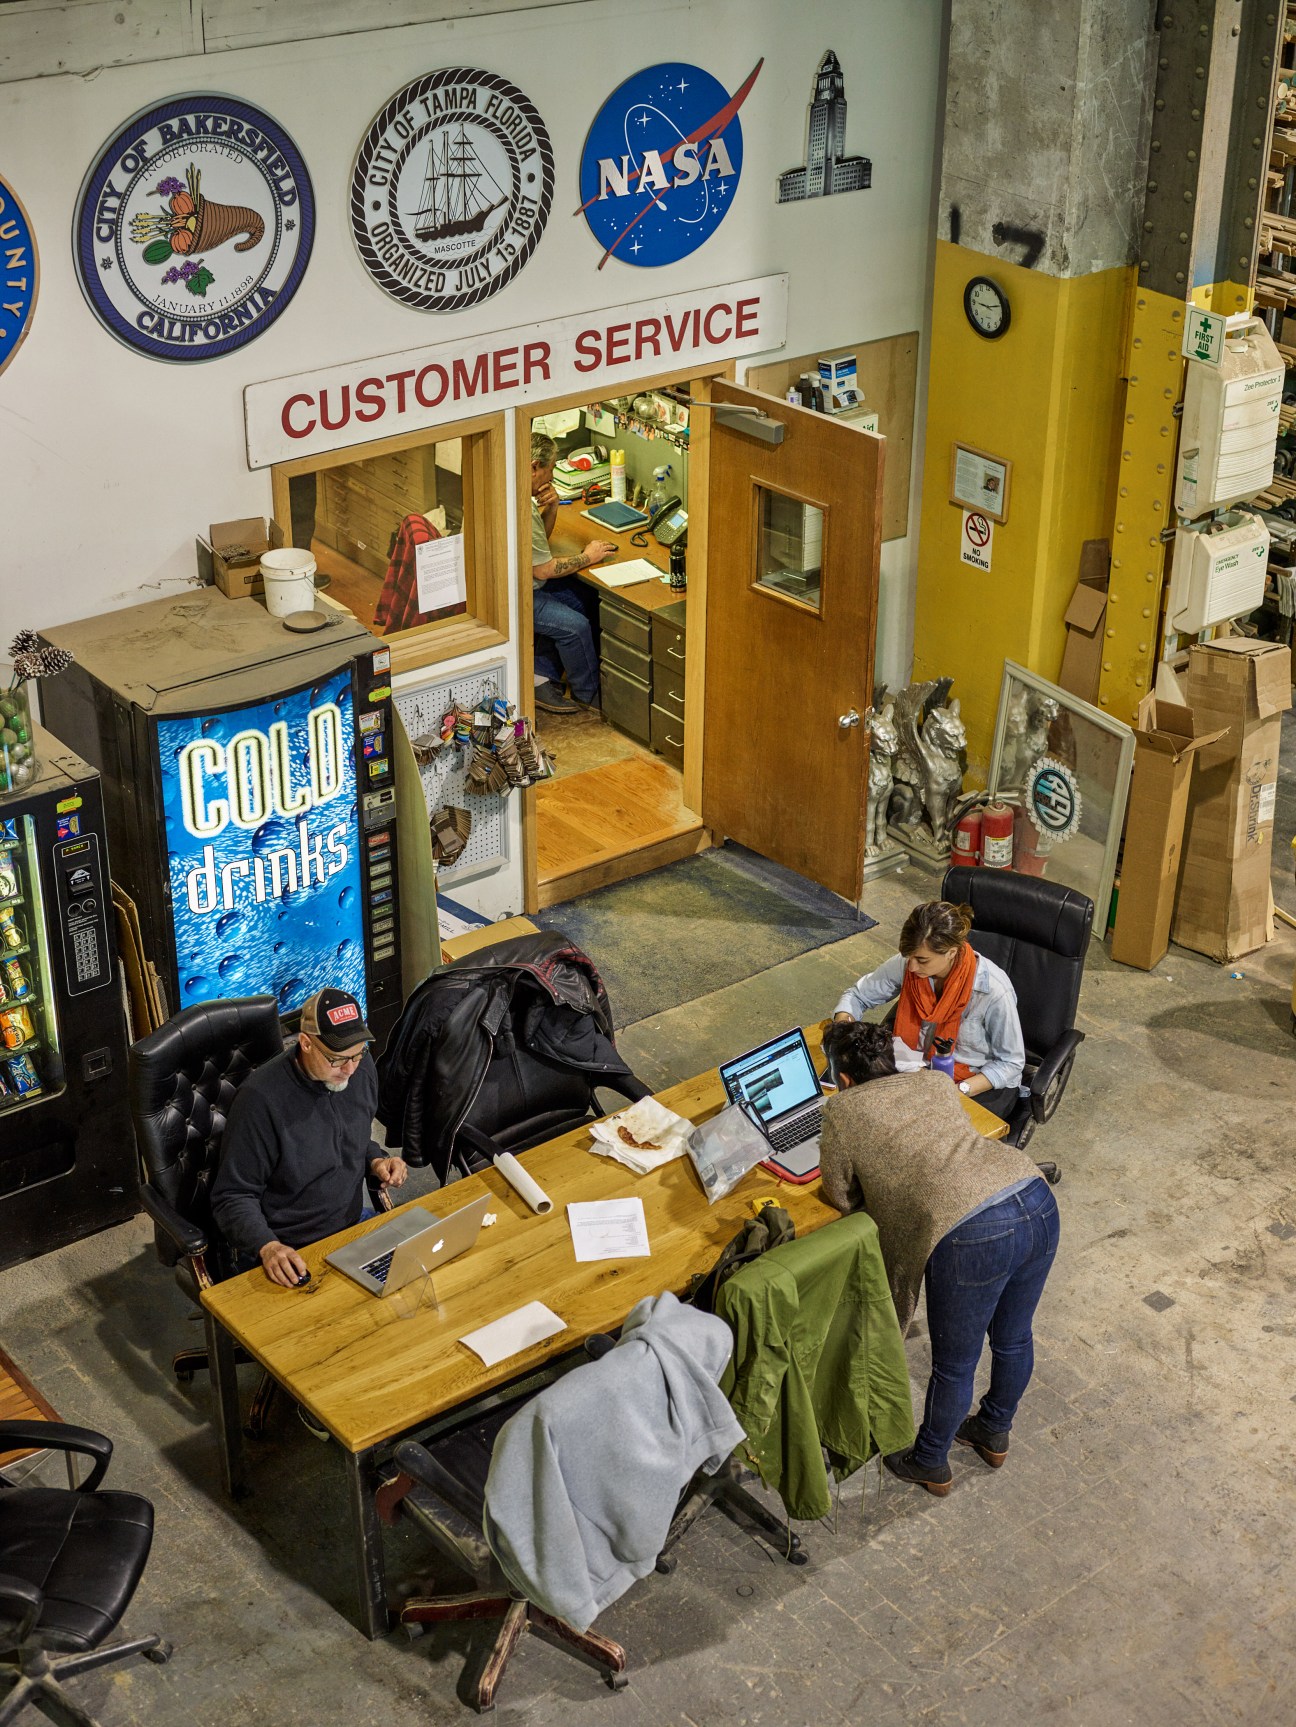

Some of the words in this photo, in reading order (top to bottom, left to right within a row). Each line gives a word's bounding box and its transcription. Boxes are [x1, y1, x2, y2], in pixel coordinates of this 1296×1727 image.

[368, 138, 399, 187] CITY
[393, 109, 415, 140] OF
[419, 86, 478, 118] TAMPA
[484, 93, 537, 164] FLORIDA
[140, 143, 245, 183] INCORPORATED
[597, 137, 736, 201] NASA
[96, 179, 124, 243] CITY
[120, 138, 150, 175] OF
[156, 114, 298, 207] BAKERSFIELD
[370, 221, 446, 293] ORGANIZED
[455, 258, 493, 292] JULY
[495, 238, 517, 264] 15
[511, 194, 538, 239] 1887
[434, 239, 477, 255] MASCOTTE
[136, 285, 277, 343] CALIFORNIA
[152, 294, 216, 314] JANUARY
[1195, 331, 1214, 344] FIRST
[1198, 342, 1210, 352] AID
[281, 341, 552, 439] CUSTOMER
[573, 297, 761, 373] SERVICE
[1255, 377, 1278, 389] Protector
[963, 552, 989, 569] SMOKING
[972, 547, 981, 557] NO
[1215, 566, 1224, 574] Eye
[1225, 559, 1239, 571] Wash
[179, 702, 345, 838] COLD
[187, 819, 349, 914] drinks
[333, 1006, 356, 1021] ACME
